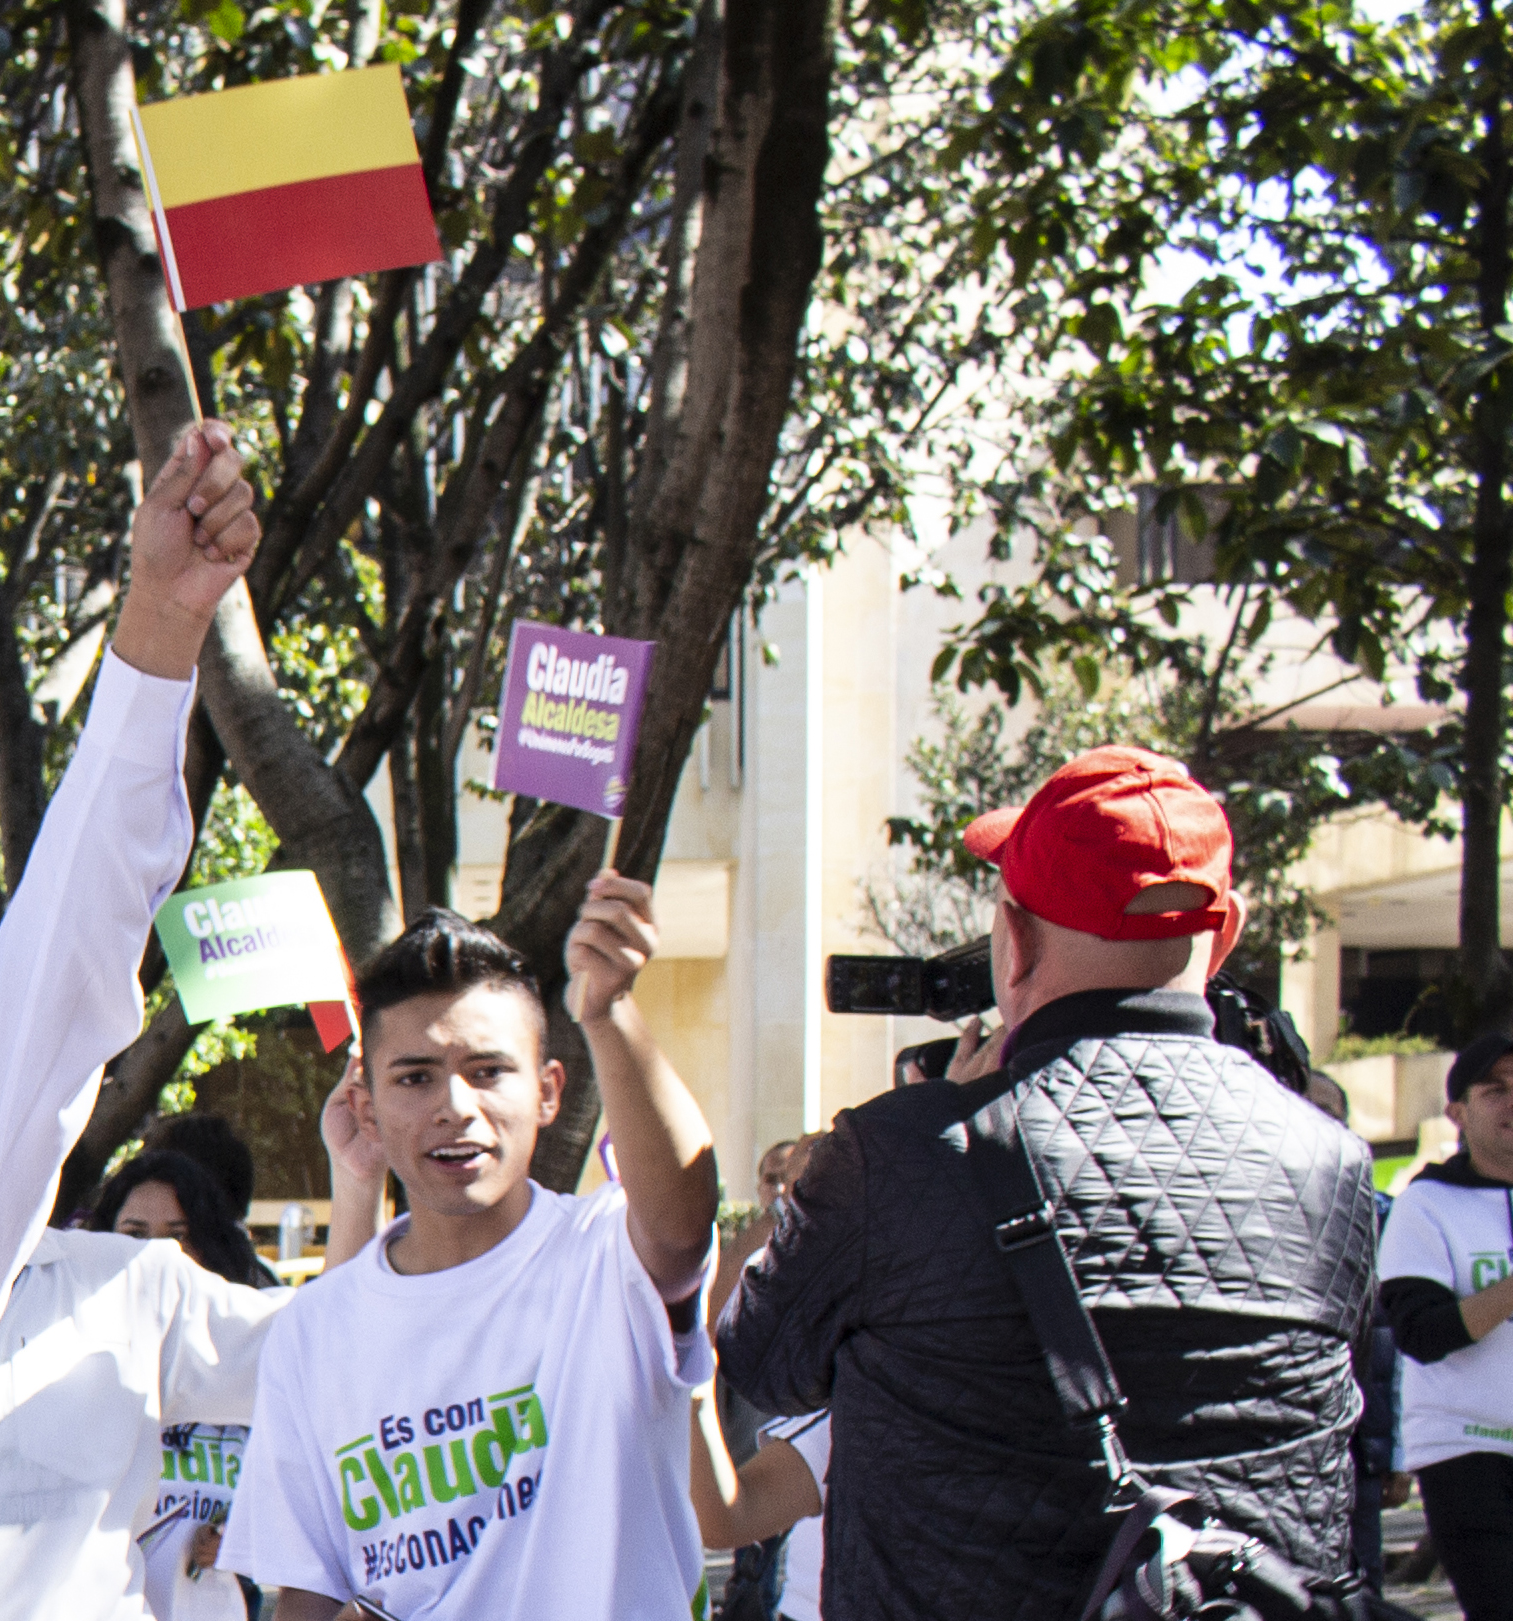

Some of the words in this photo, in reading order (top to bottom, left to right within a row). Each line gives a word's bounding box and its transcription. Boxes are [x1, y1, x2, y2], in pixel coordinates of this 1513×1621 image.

[526, 642, 629, 705] Claudia
[521, 691, 621, 742] Alcaldesa
[379, 1414, 415, 1450] Es
[423, 1396, 485, 1436] con
